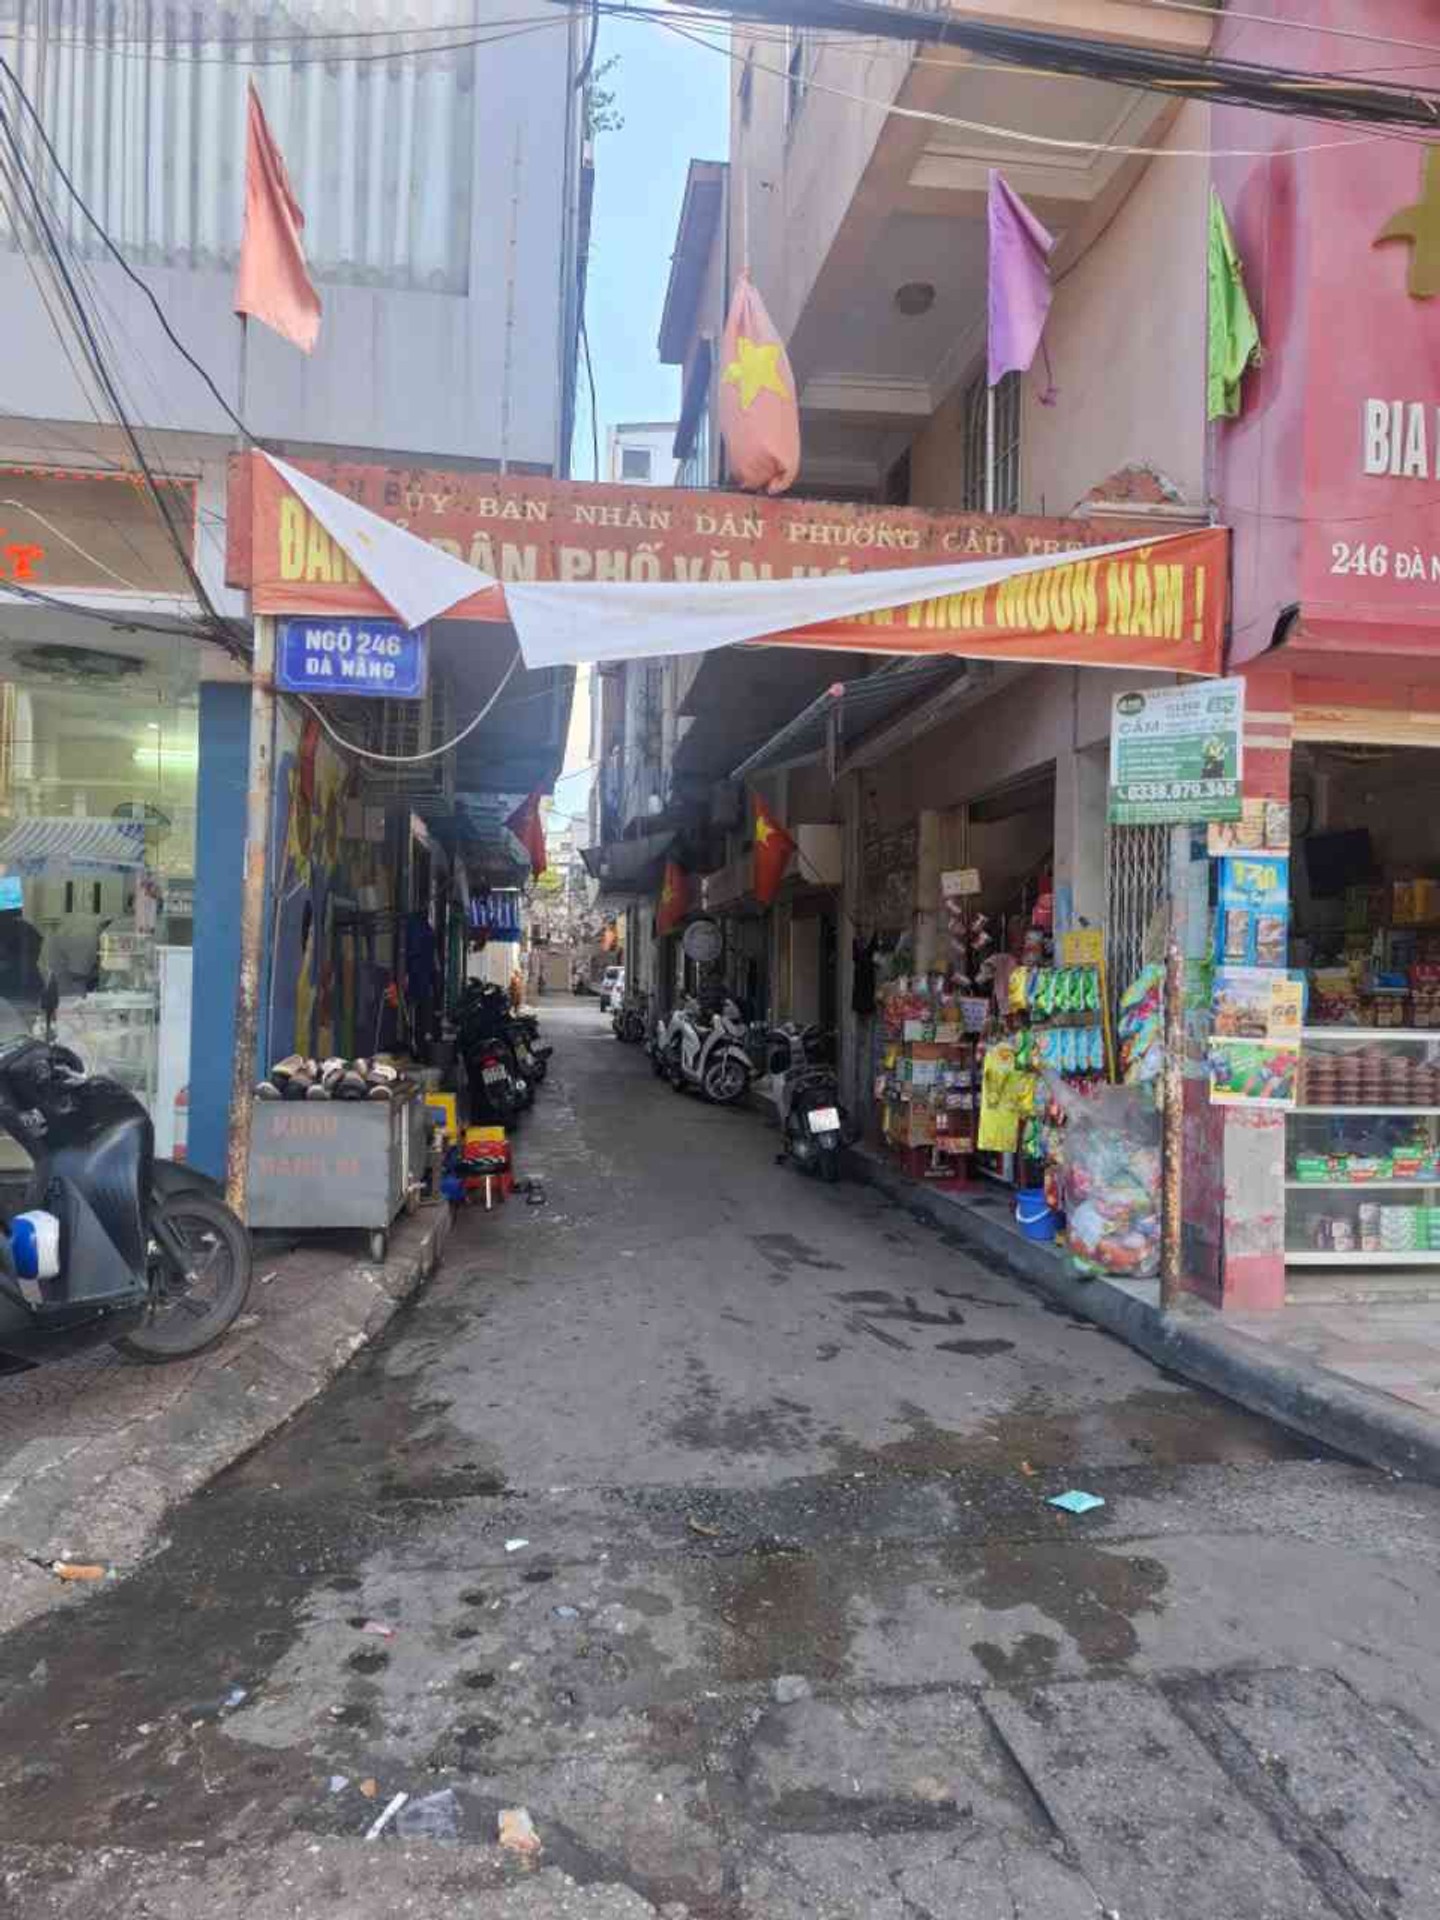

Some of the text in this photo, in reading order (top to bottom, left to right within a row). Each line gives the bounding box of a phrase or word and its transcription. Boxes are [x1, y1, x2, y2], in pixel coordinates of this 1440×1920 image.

[1364, 398, 1427, 478] BIA
[476, 497, 548, 522] BAN
[574, 503, 672, 530] NHÂN
[696, 512, 766, 540] DÂN
[1331, 543, 1388, 577] 246
[1394, 545, 1427, 580] ĐÀ
[355, 630, 402, 657] 246
